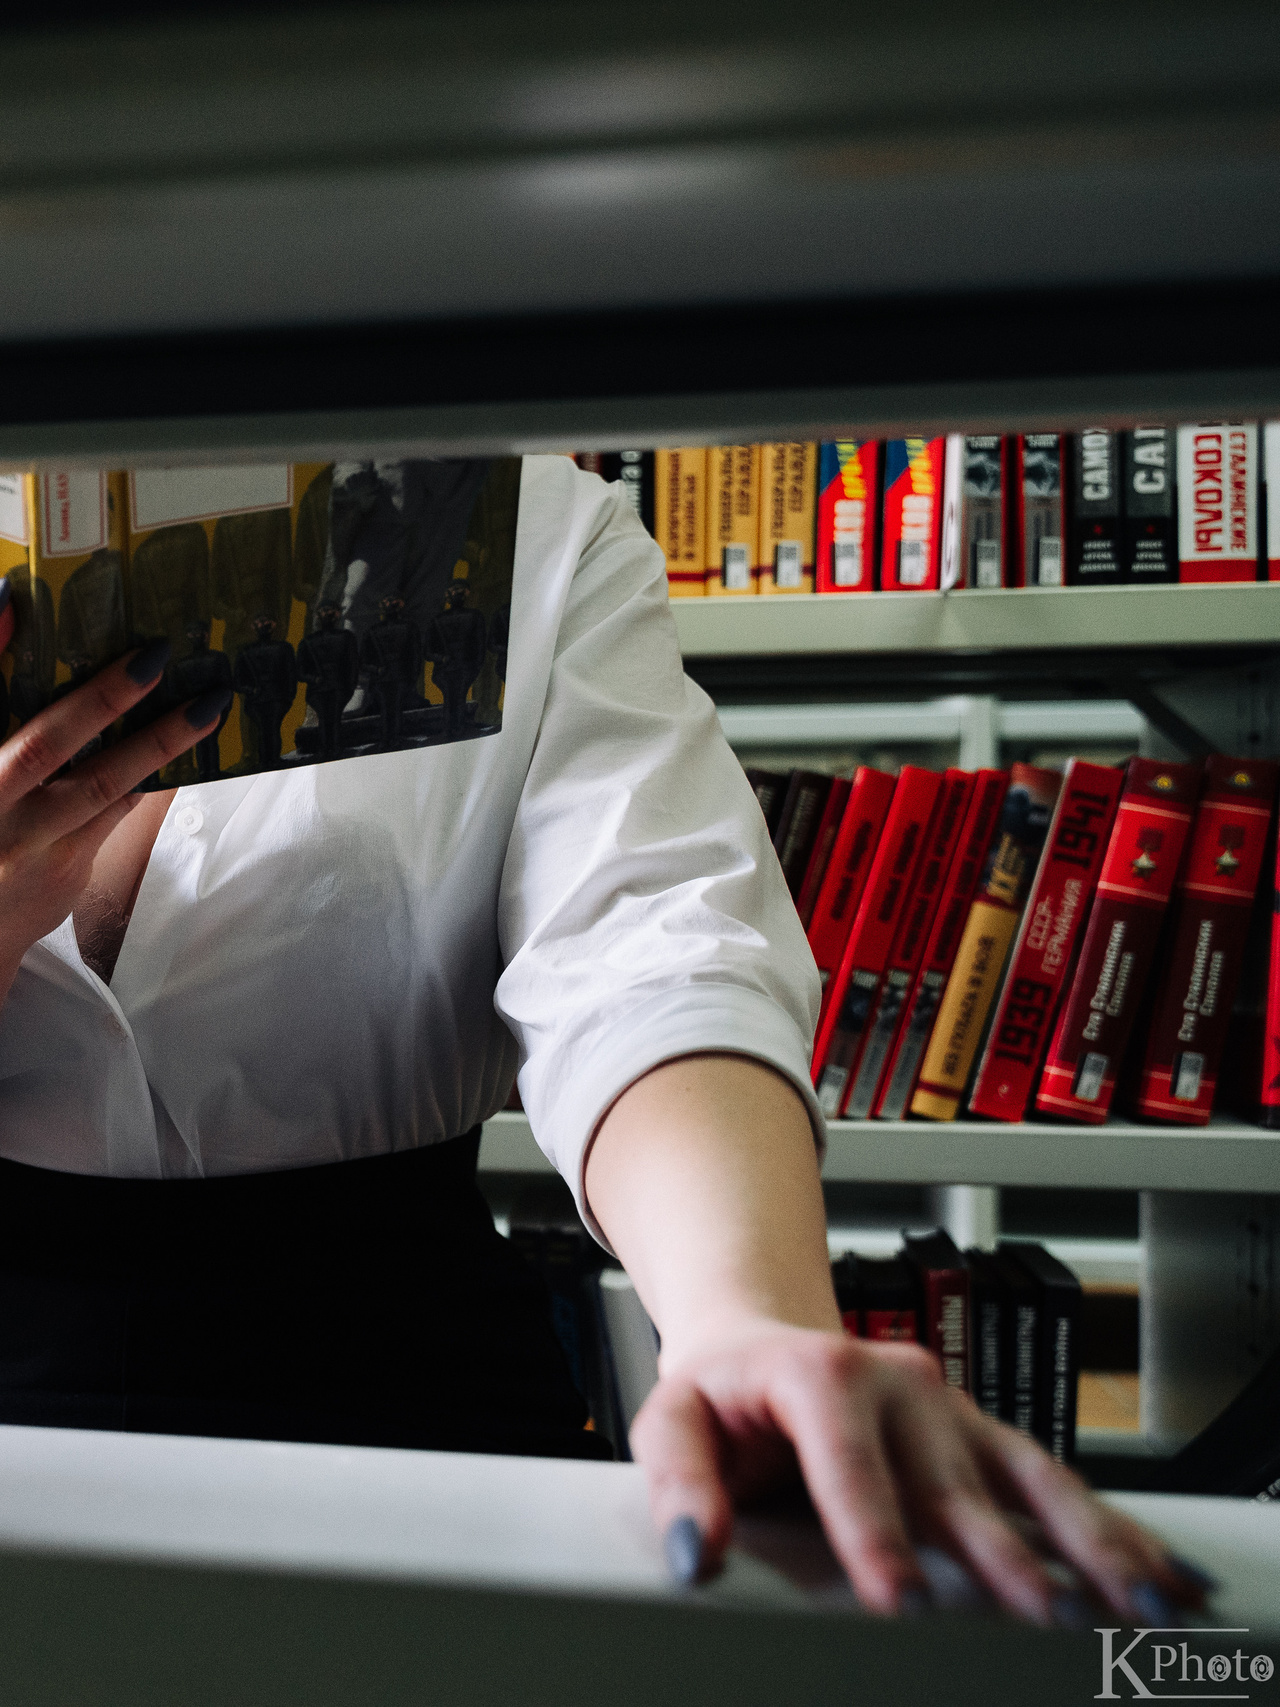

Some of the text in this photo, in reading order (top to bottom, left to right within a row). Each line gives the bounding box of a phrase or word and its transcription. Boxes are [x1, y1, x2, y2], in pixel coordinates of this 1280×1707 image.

[1194, 433, 1222, 552] СОКОЛЫ
[1229, 432, 1247, 552] СТАЛИНСКИЕ
[1053, 790, 1108, 870] 1941
[1041, 879, 1083, 975] ГЕРМАНИЯ
[995, 977, 1051, 1065] 1939
[936, 1295, 964, 1352] ВОЙНЫ
